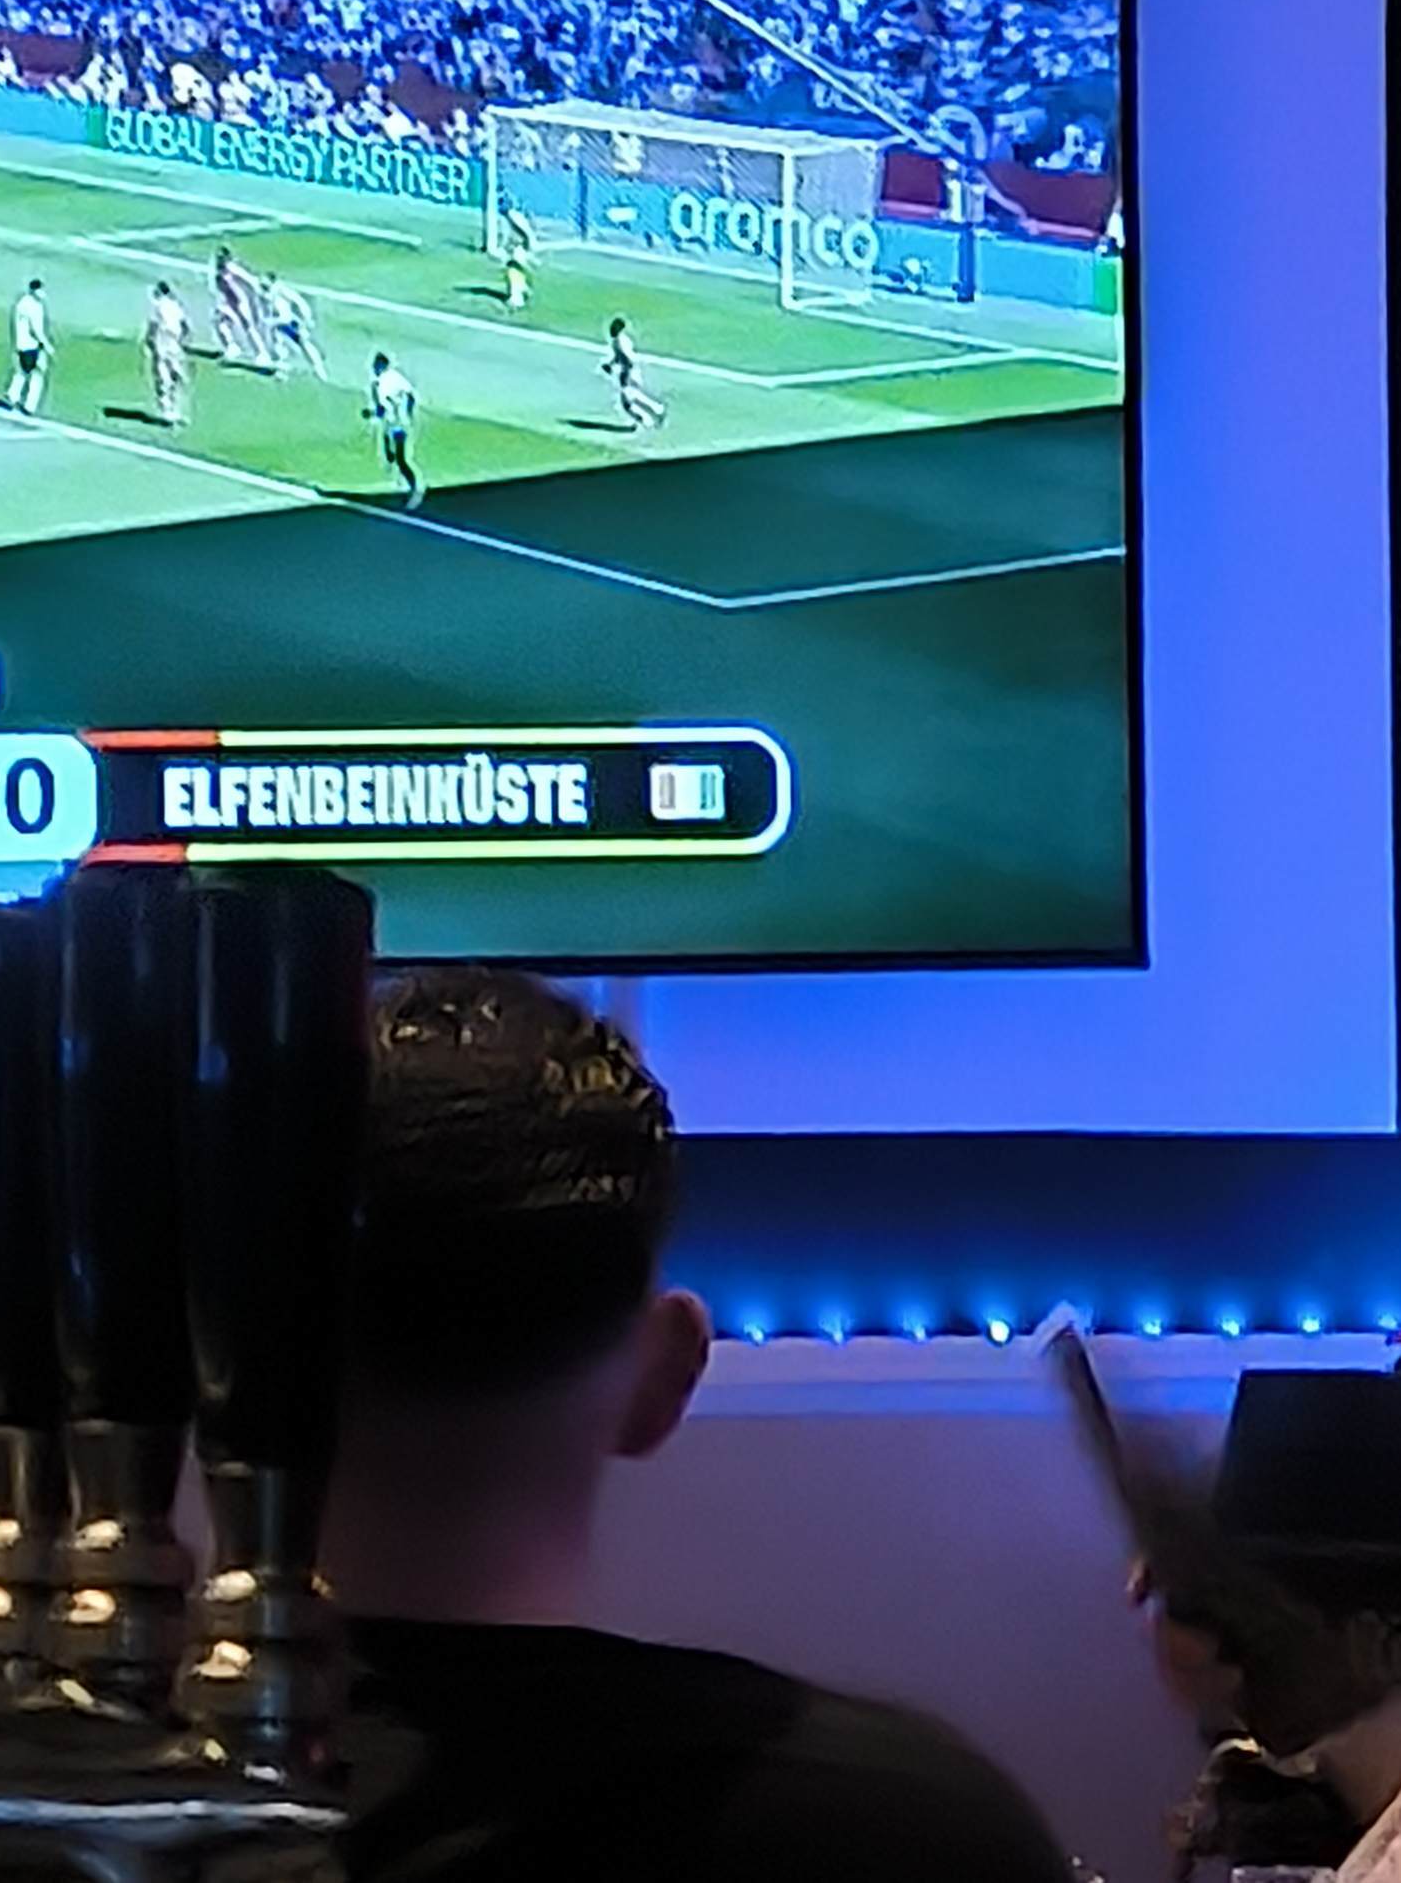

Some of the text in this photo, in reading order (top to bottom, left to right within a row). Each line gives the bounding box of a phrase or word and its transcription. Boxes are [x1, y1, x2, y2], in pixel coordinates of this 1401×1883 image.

[105, 110, 471, 200] GLOBAL ENERGY PARTNER
[669, 191, 880, 269] aramco
[4, 757, 55, 835] 0
[162, 751, 589, 828] ELFENBEINKÜSTE
